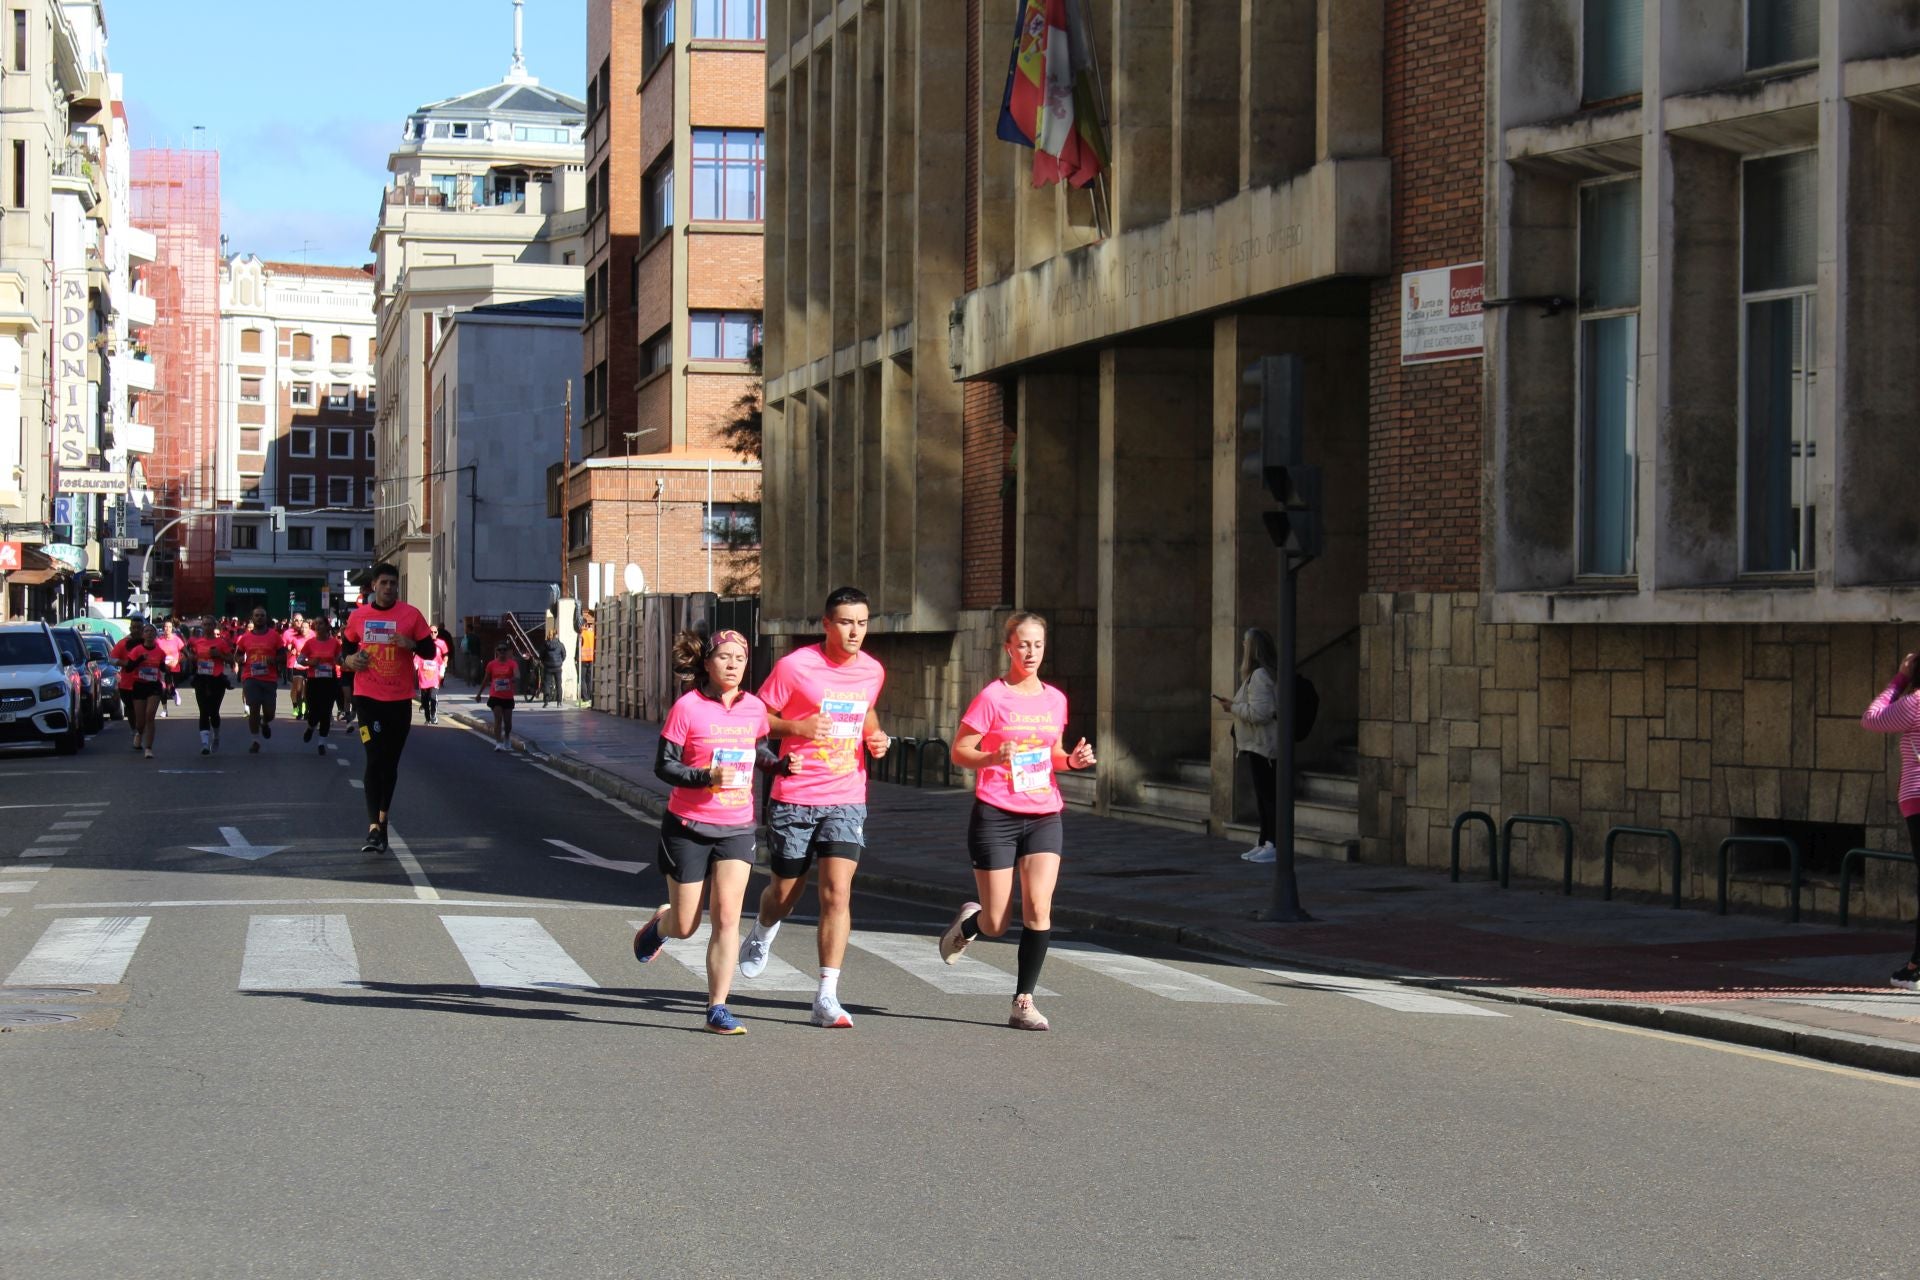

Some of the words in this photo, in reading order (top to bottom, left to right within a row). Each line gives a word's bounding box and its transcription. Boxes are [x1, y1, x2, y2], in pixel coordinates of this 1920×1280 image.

[1124, 262, 1138, 298] DE
[1437, 299, 1443, 307] de
[1450, 302, 1458, 314] de
[62, 279, 85, 461] ADONIAS
[59, 477, 125, 489] restaurante
